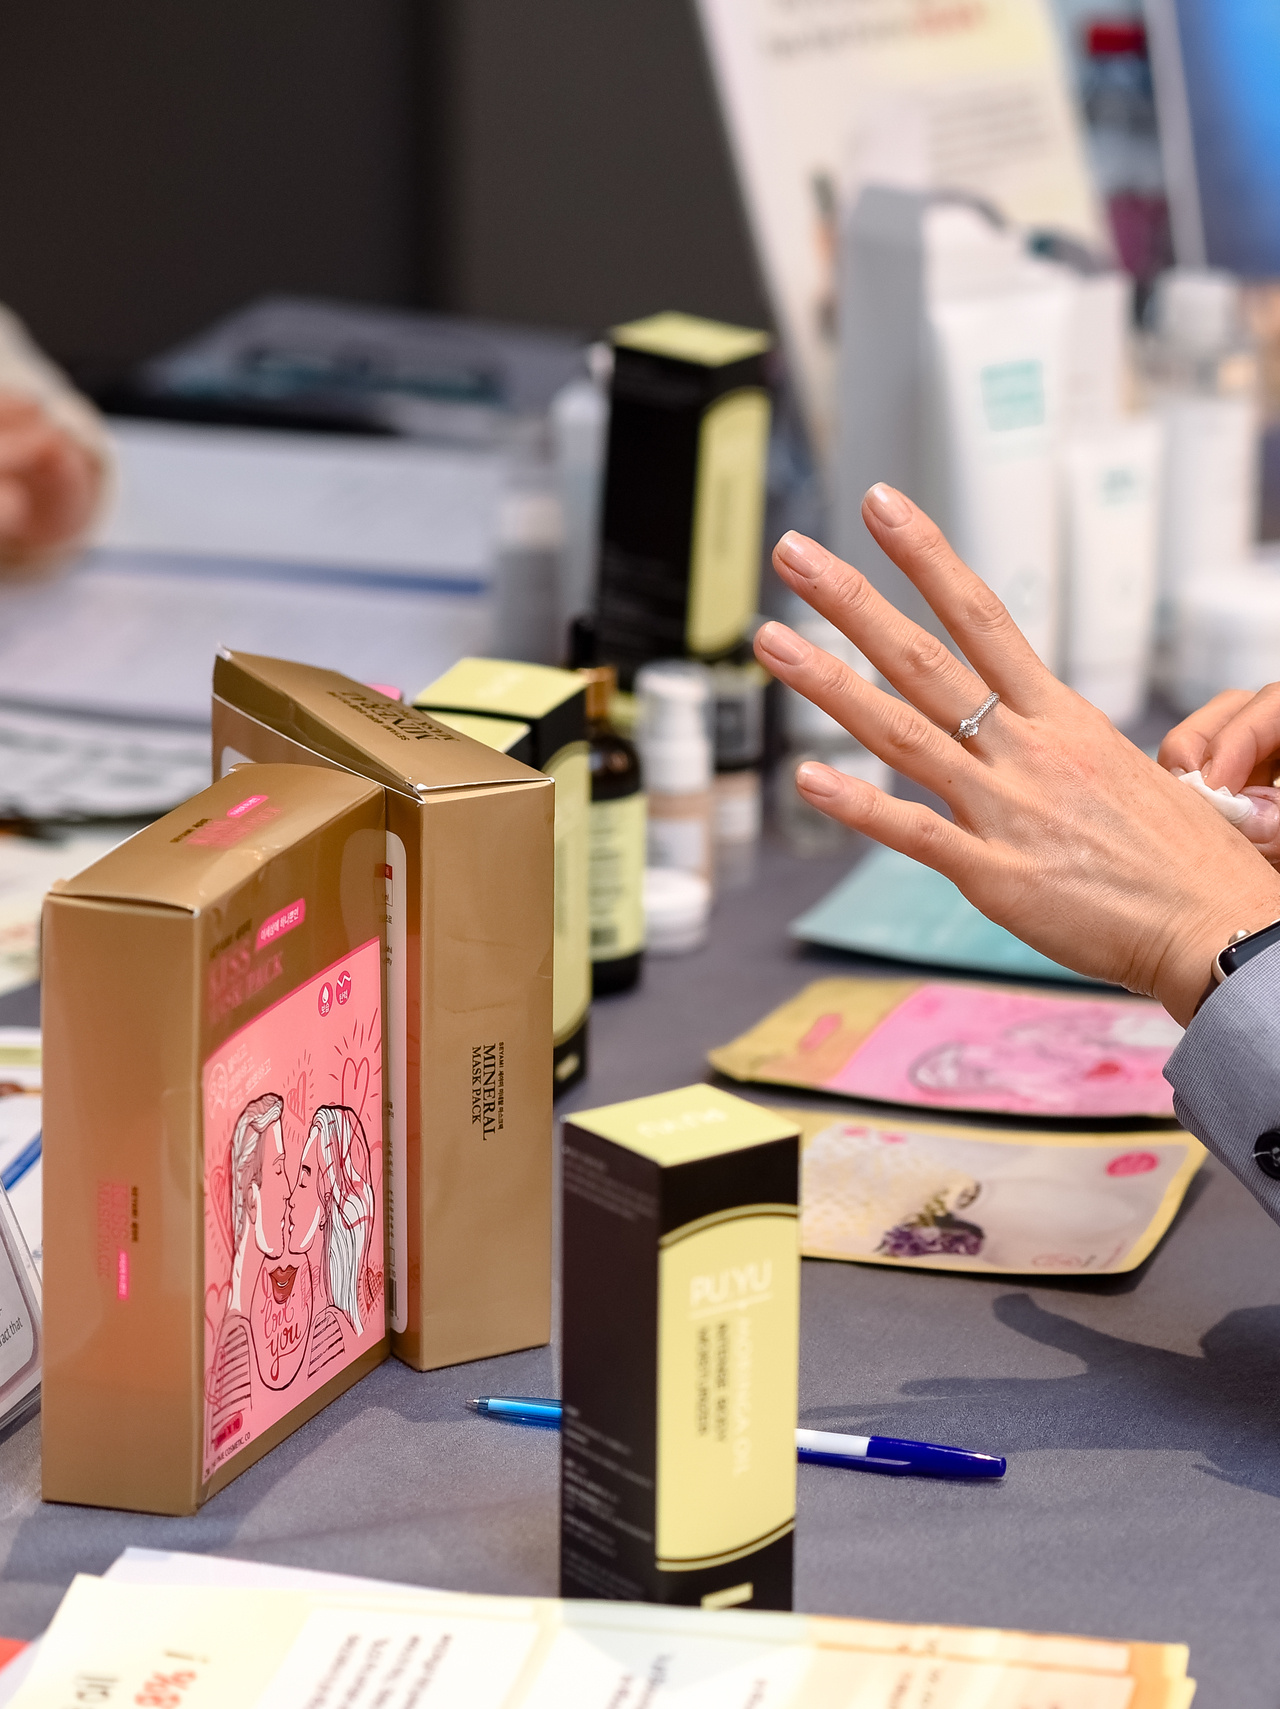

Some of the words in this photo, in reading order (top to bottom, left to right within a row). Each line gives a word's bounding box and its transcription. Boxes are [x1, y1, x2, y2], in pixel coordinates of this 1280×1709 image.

[472, 1046, 482, 1086] MASK
[472, 1087, 481, 1124] PACK
[483, 1043, 496, 1141] MINERAL
[0, 1327, 12, 1348] act
[9, 1316, 23, 1336] that
[266, 1322, 303, 1381] you
